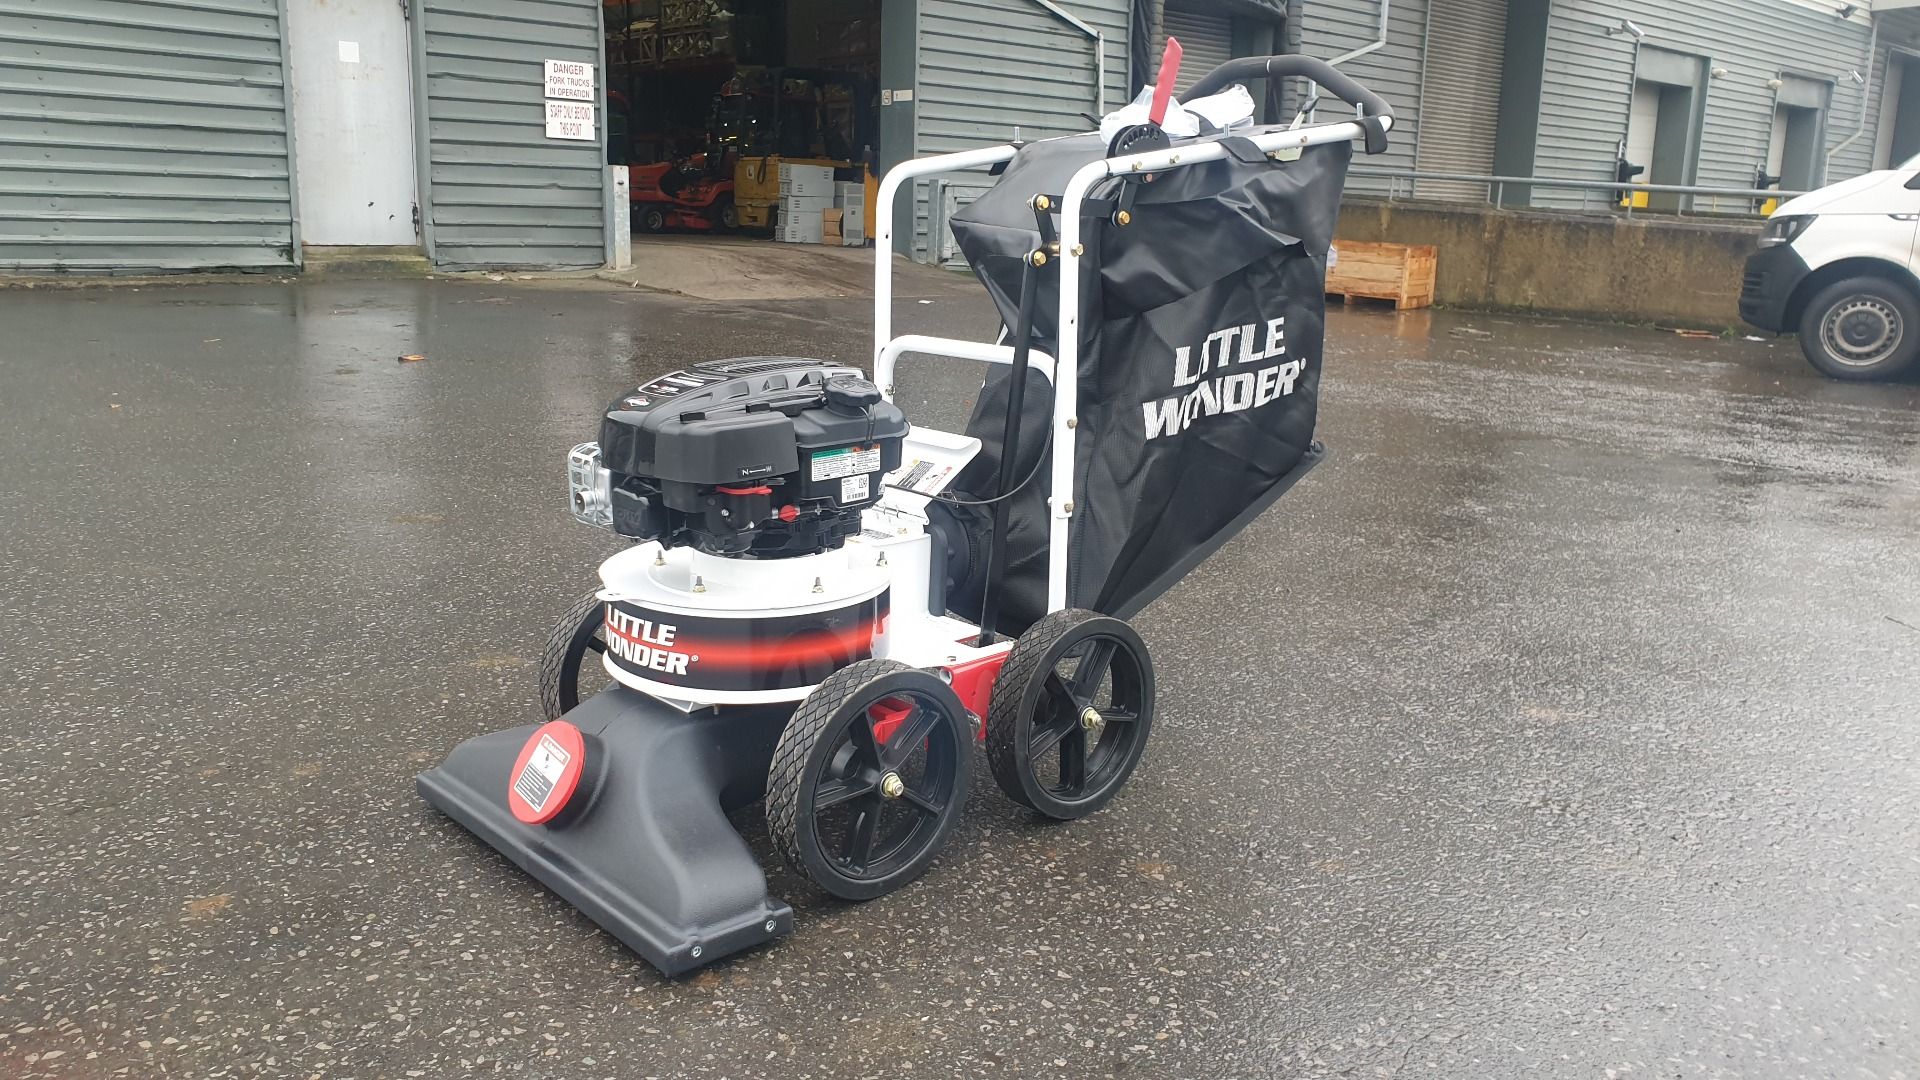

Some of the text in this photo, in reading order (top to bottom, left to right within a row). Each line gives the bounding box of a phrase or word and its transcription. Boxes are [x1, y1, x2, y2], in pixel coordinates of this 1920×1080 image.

[553, 63, 584, 75] DANGER
[549, 76, 590, 88] FORK TRUCKS
[549, 87, 590, 98] IN OPERATION
[607, 603, 677, 647] LITTLE
